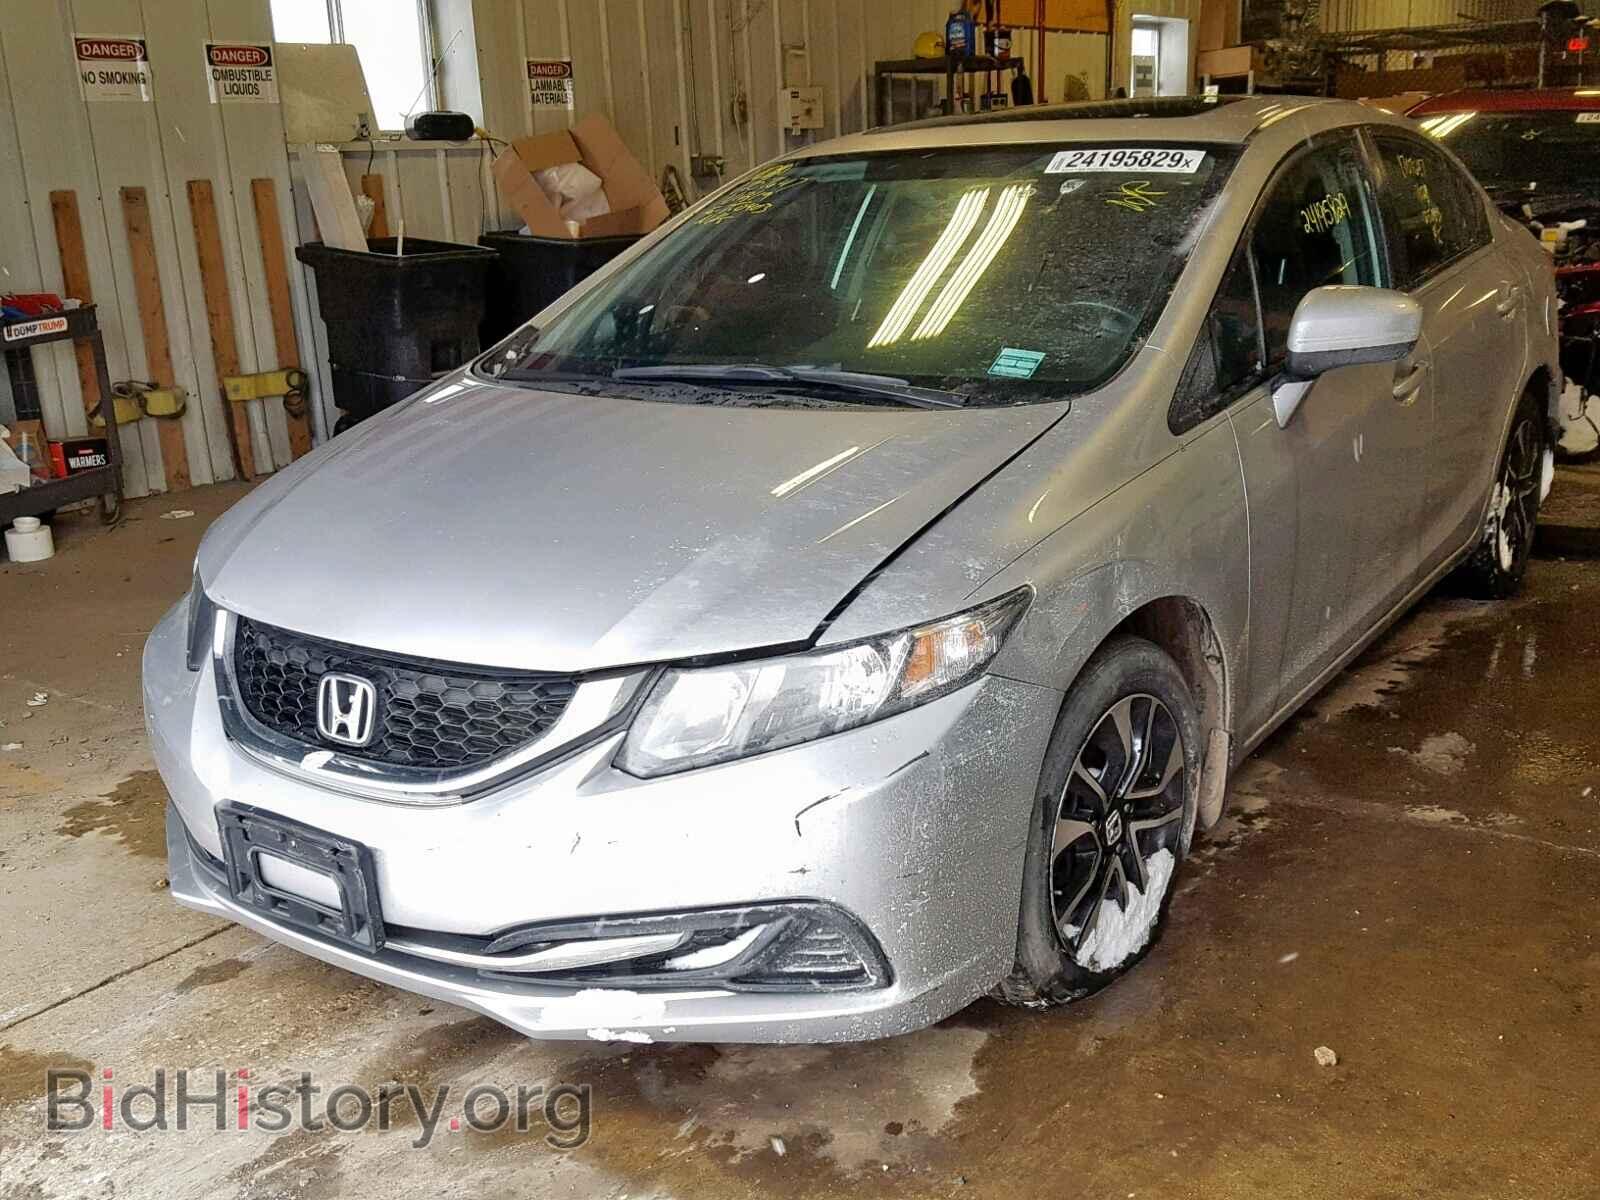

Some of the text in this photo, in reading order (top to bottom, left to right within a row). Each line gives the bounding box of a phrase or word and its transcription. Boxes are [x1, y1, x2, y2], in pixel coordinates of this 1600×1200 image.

[81, 43, 136, 56] DANGER
[213, 50, 261, 62] DANGER
[211, 68, 273, 82] OMBUSTIBLE
[530, 65, 564, 75] DANGER
[80, 70, 146, 85] NO SMOKING
[223, 82, 260, 96] LIQUIDS
[530, 79, 573, 92] LAMMABLE
[68, 454, 107, 469] WARMERS
